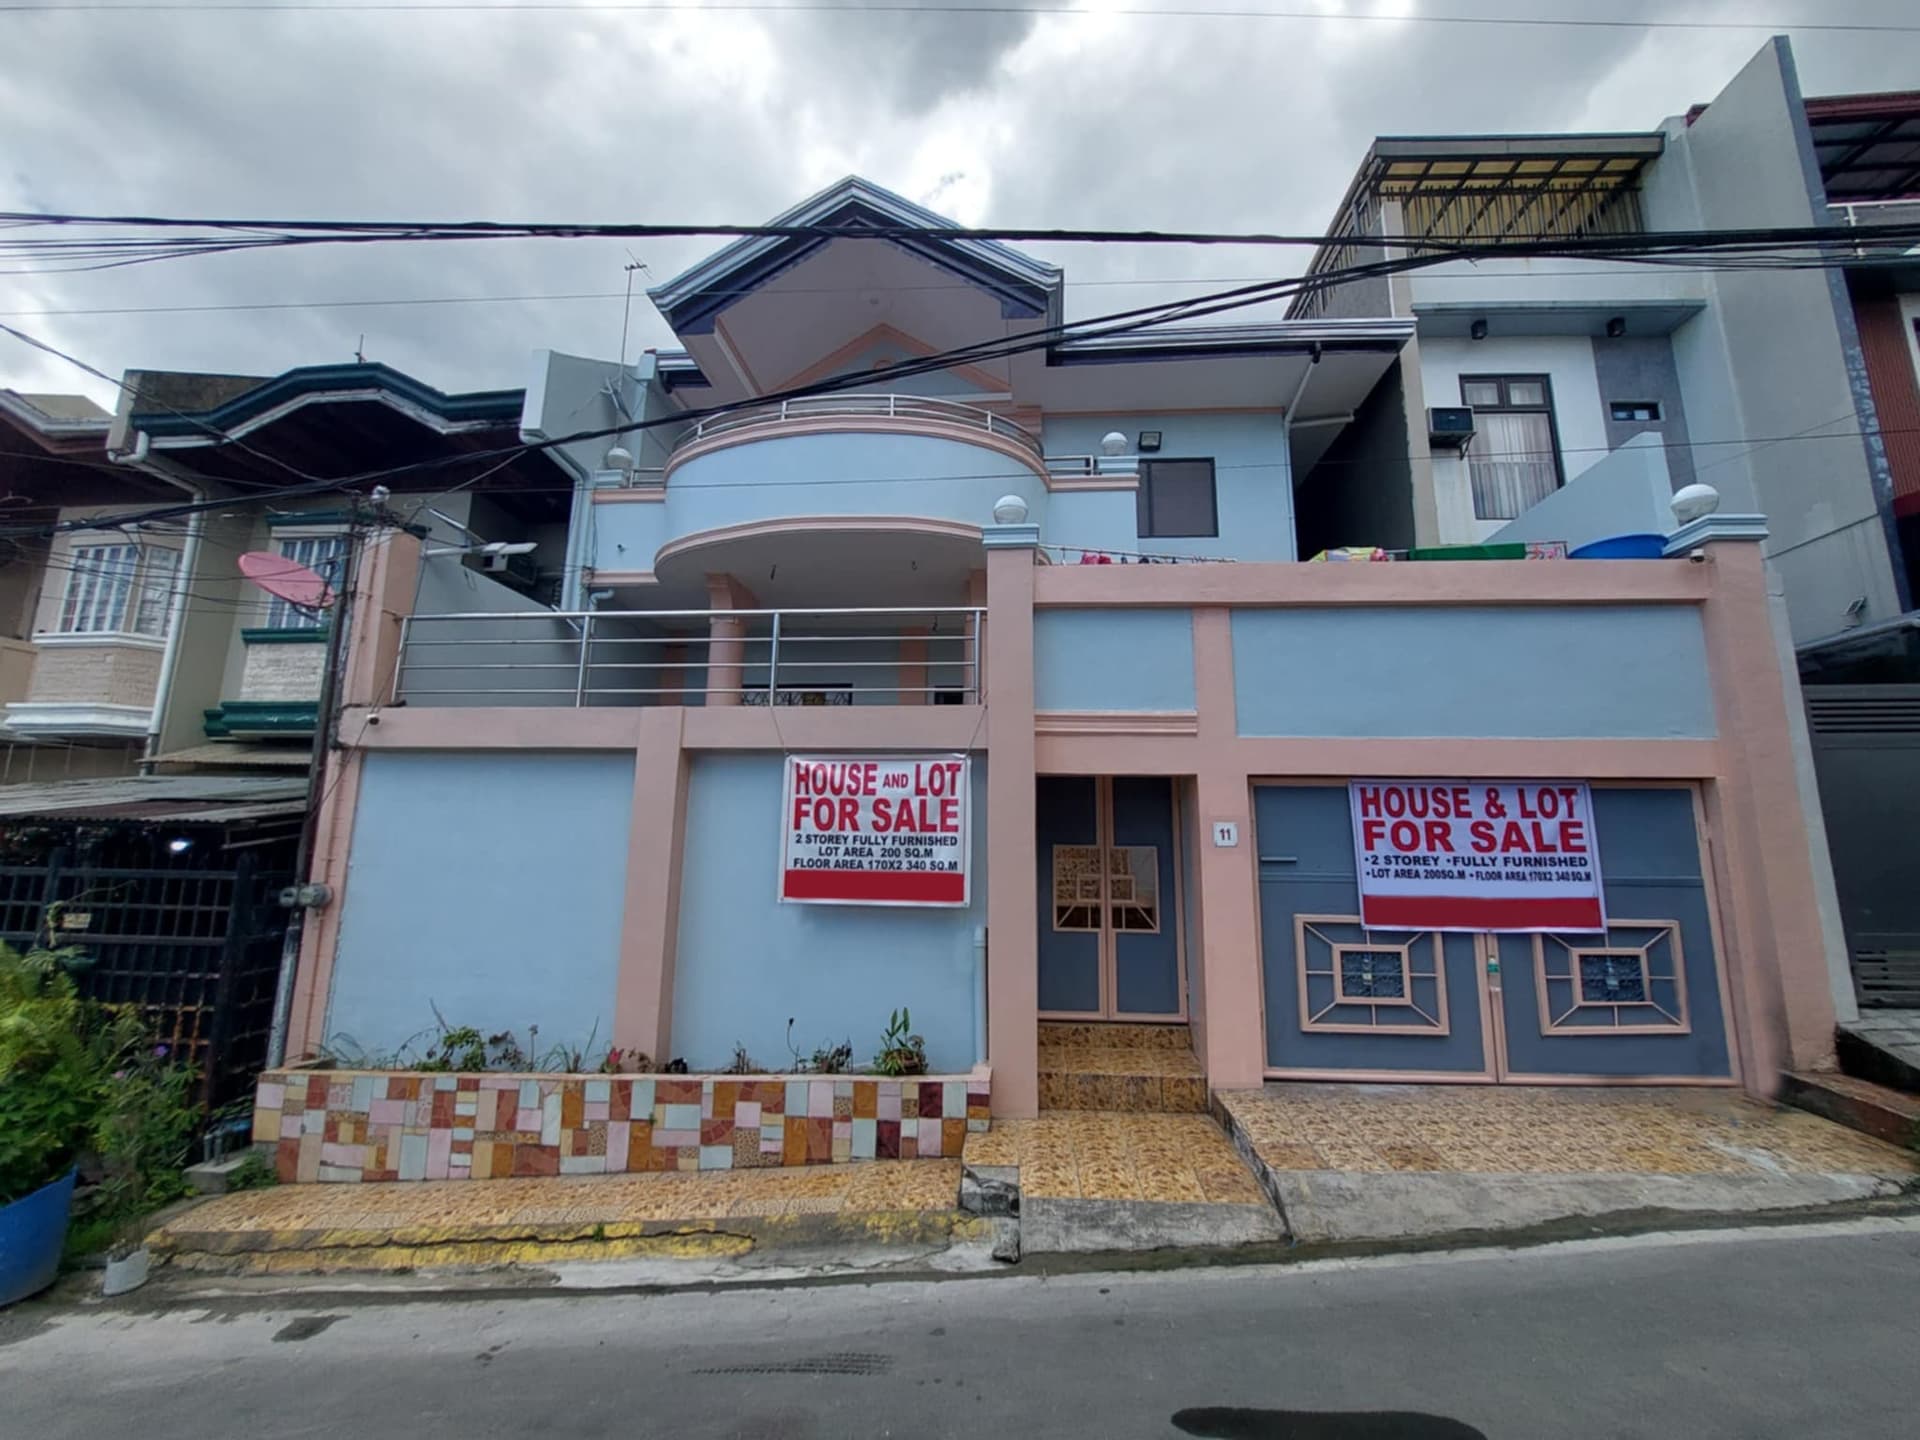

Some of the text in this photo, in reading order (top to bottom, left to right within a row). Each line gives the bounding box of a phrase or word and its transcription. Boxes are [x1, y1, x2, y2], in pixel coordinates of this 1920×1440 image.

[795, 763, 962, 797] HOUSE AND LOT
[1360, 787, 1579, 819] HOUSE & LOT
[793, 797, 959, 833] FOR SALE
[795, 833, 958, 847] 2 STOREY FULLY FURNISHED
[1219, 828, 1231, 841] 11
[1363, 820, 1588, 853] FOR SALE
[818, 846, 933, 859] LOT AREA 200 SQ.M
[793, 858, 958, 871] FLOOR AREA 170X2 340 SQ.M
[1383, 855, 1440, 866] STOREY
[1503, 856, 1588, 868] FURNISHED
[1394, 868, 1420, 879] AREA
[1505, 870, 1527, 881] AREA
